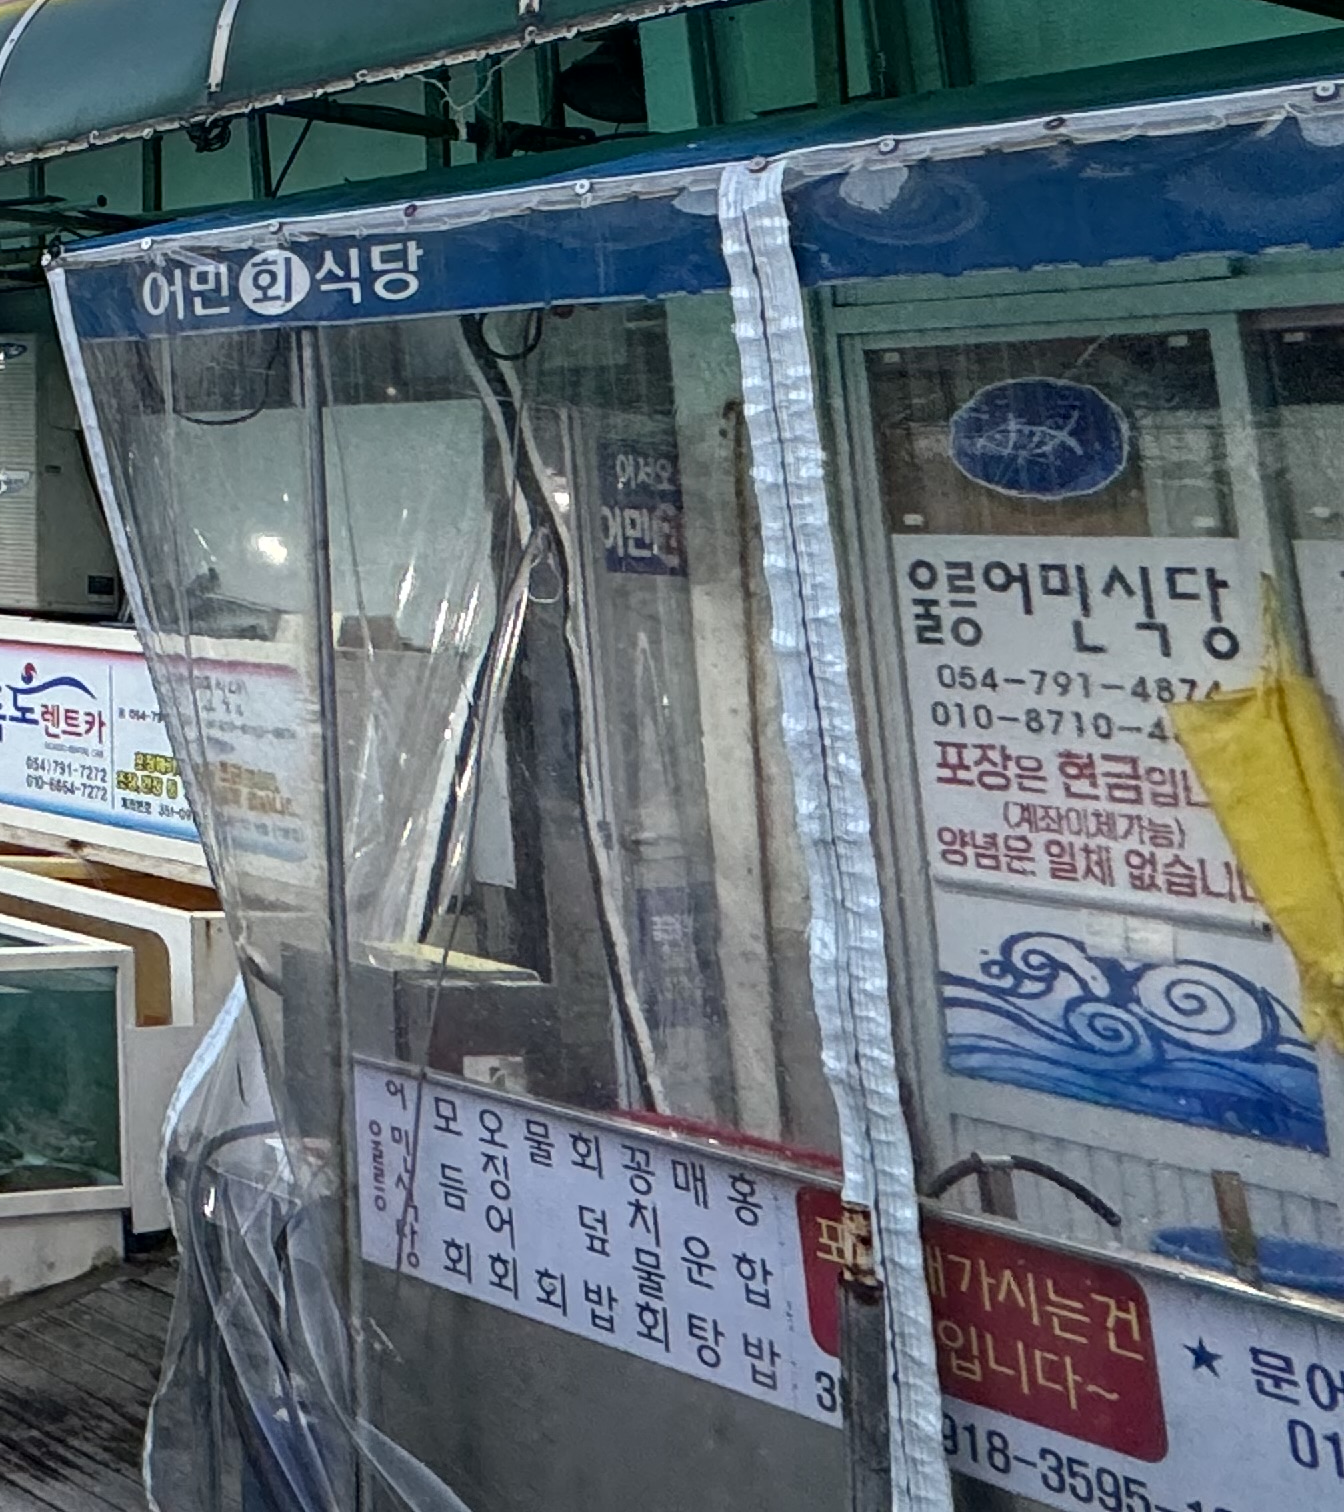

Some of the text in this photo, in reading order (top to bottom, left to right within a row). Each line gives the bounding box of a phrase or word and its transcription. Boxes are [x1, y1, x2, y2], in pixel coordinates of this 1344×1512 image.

[931, 701, 1180, 742] 010-8710-4
[935, 740, 1047, 794] 포장은
[937, 664, 1222, 703] 054-791-4874
[936, 826, 1036, 877] 양념은
[1044, 839, 1116, 888] 일체
[431, 1096, 473, 1285] 모듬회
[477, 1108, 519, 1300] 오징어회
[570, 1132, 619, 1334] 회덮밥
[620, 1144, 672, 1354] 꽁치물회
[671, 1159, 726, 1369] 매운탕
[727, 1172, 781, 1391] 홍합밥
